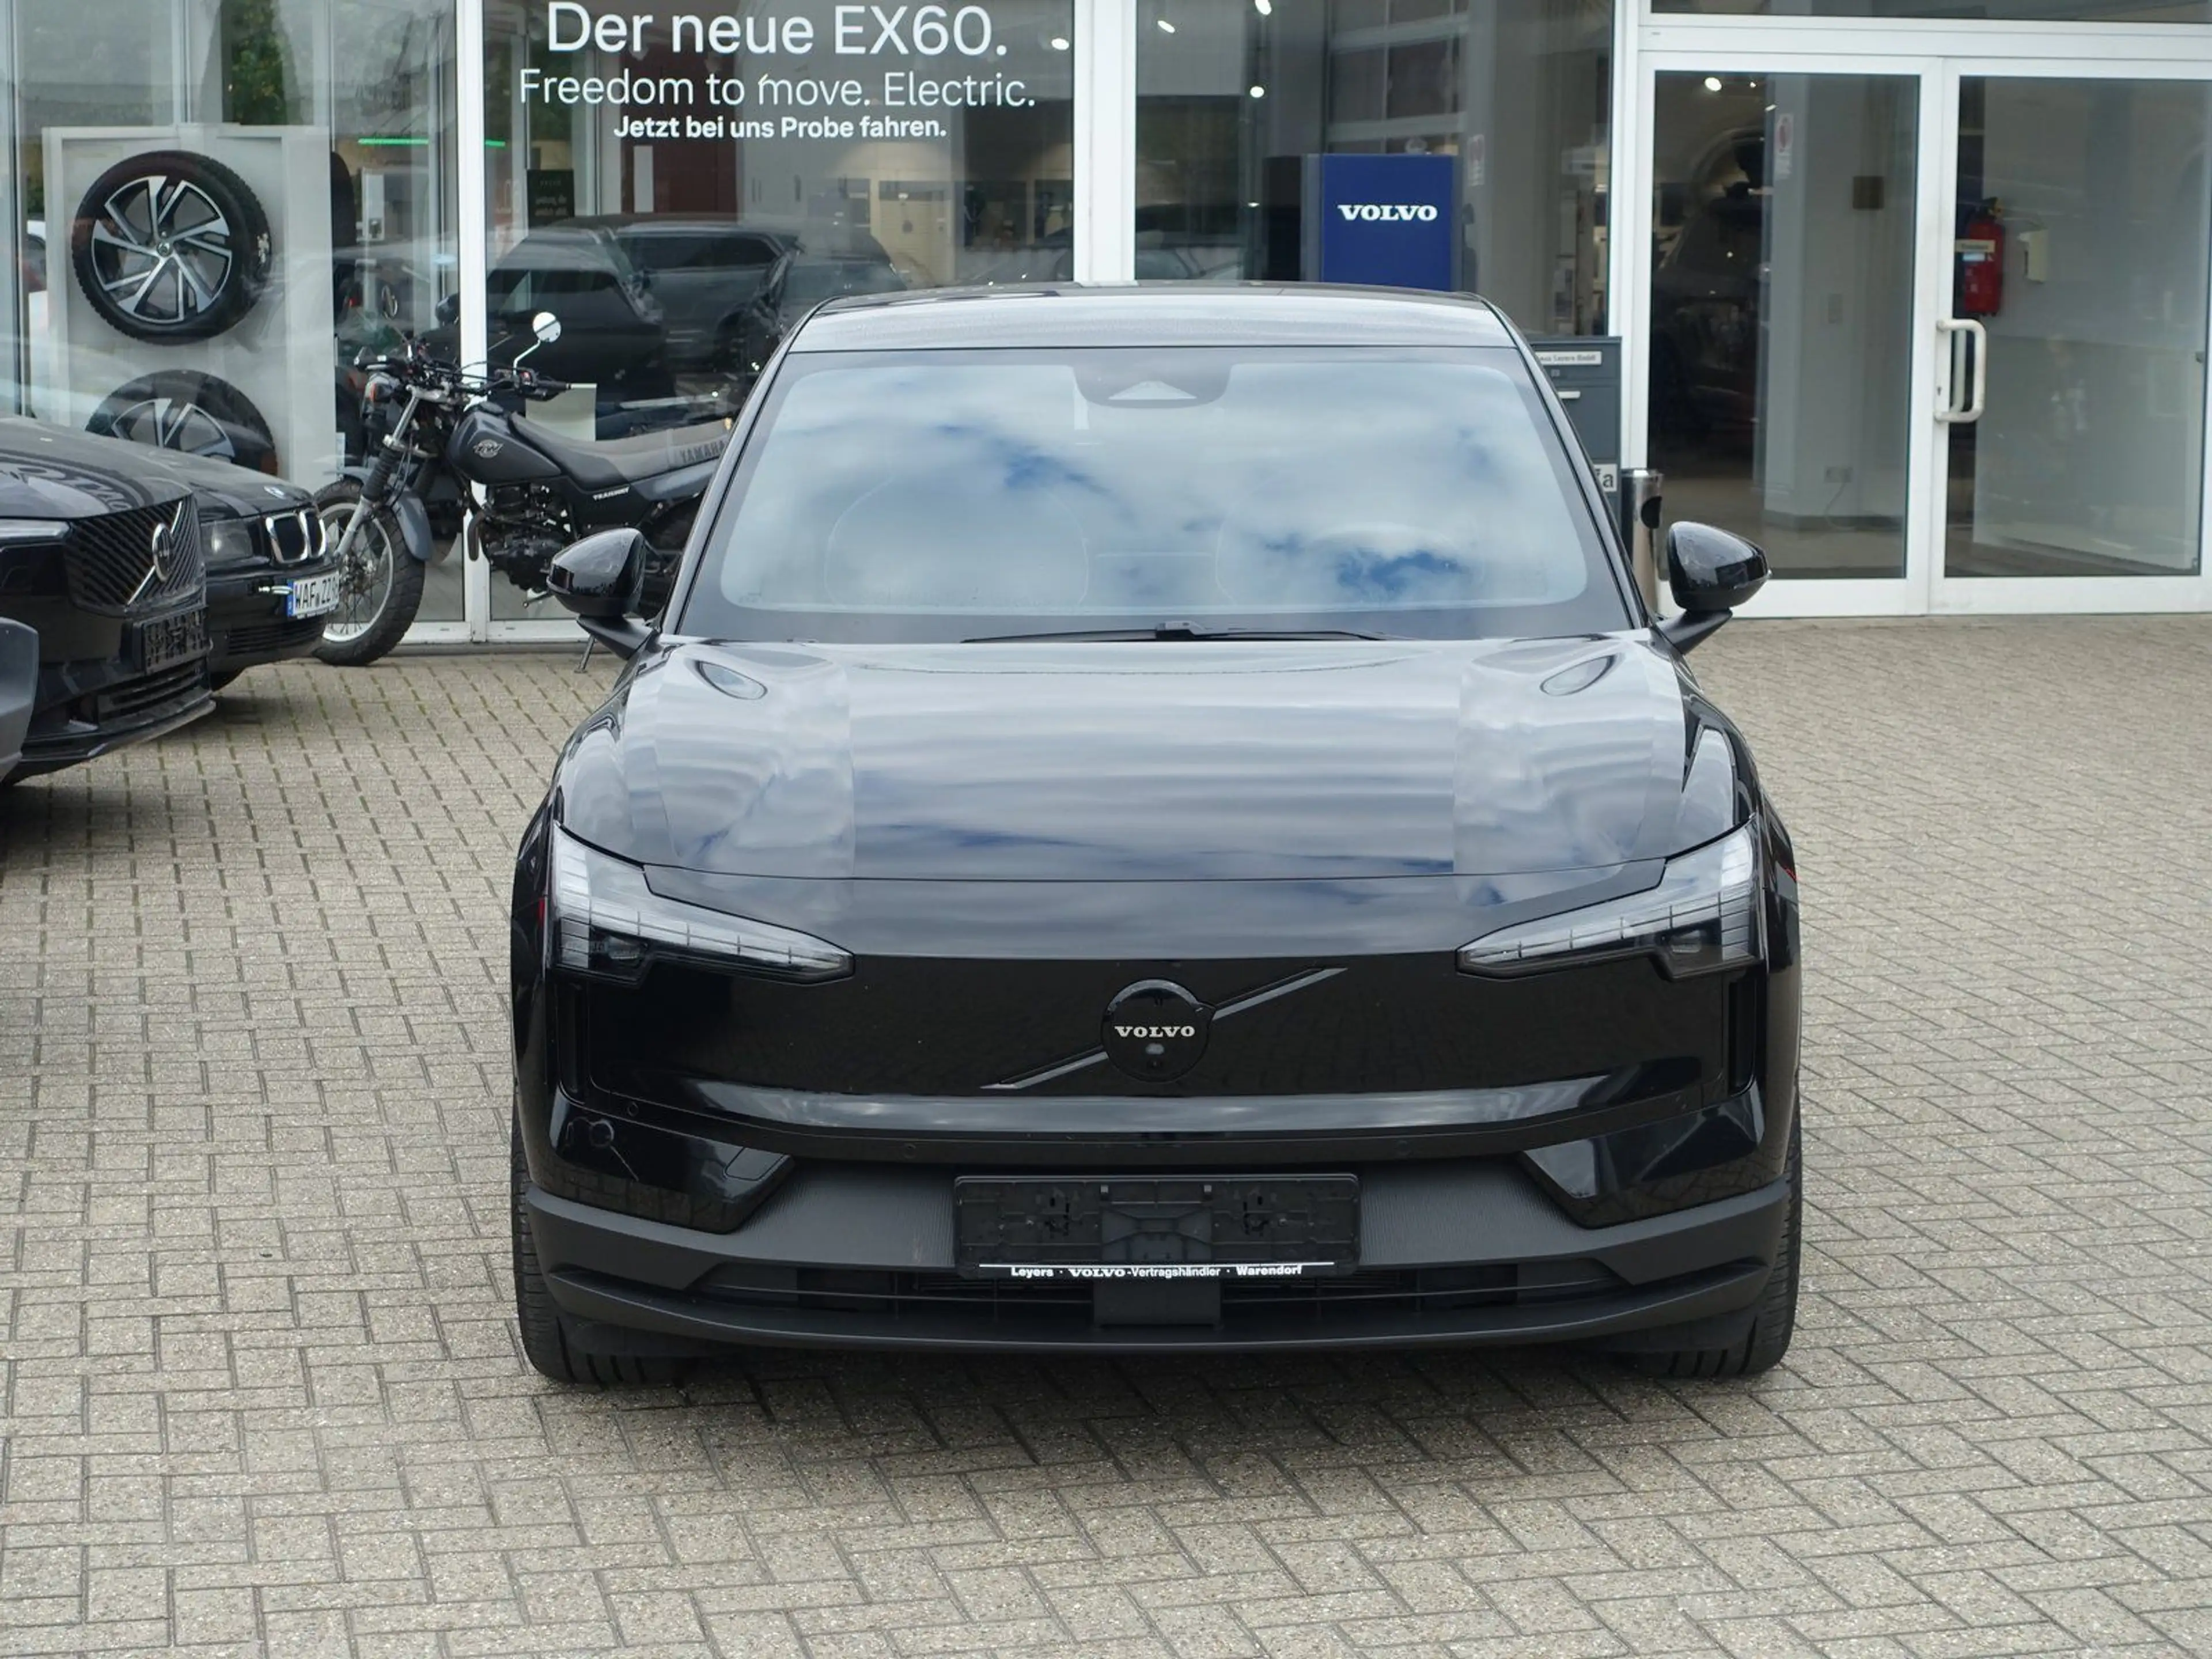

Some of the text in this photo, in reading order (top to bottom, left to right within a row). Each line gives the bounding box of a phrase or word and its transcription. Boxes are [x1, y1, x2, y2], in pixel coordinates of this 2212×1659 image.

[548, 2, 1007, 56] Der neue EX60.
[520, 68, 1035, 107] Freedom to move. Electric.
[613, 115, 947, 139] Jetzt bei uns Probe fahren.
[1337, 204, 1438, 222] VOLVO
[1114, 1025, 1195, 1038] VOLVO
[1010, 1267, 1054, 1279] Leyers
[1236, 1265, 1302, 1275] Warendorf
